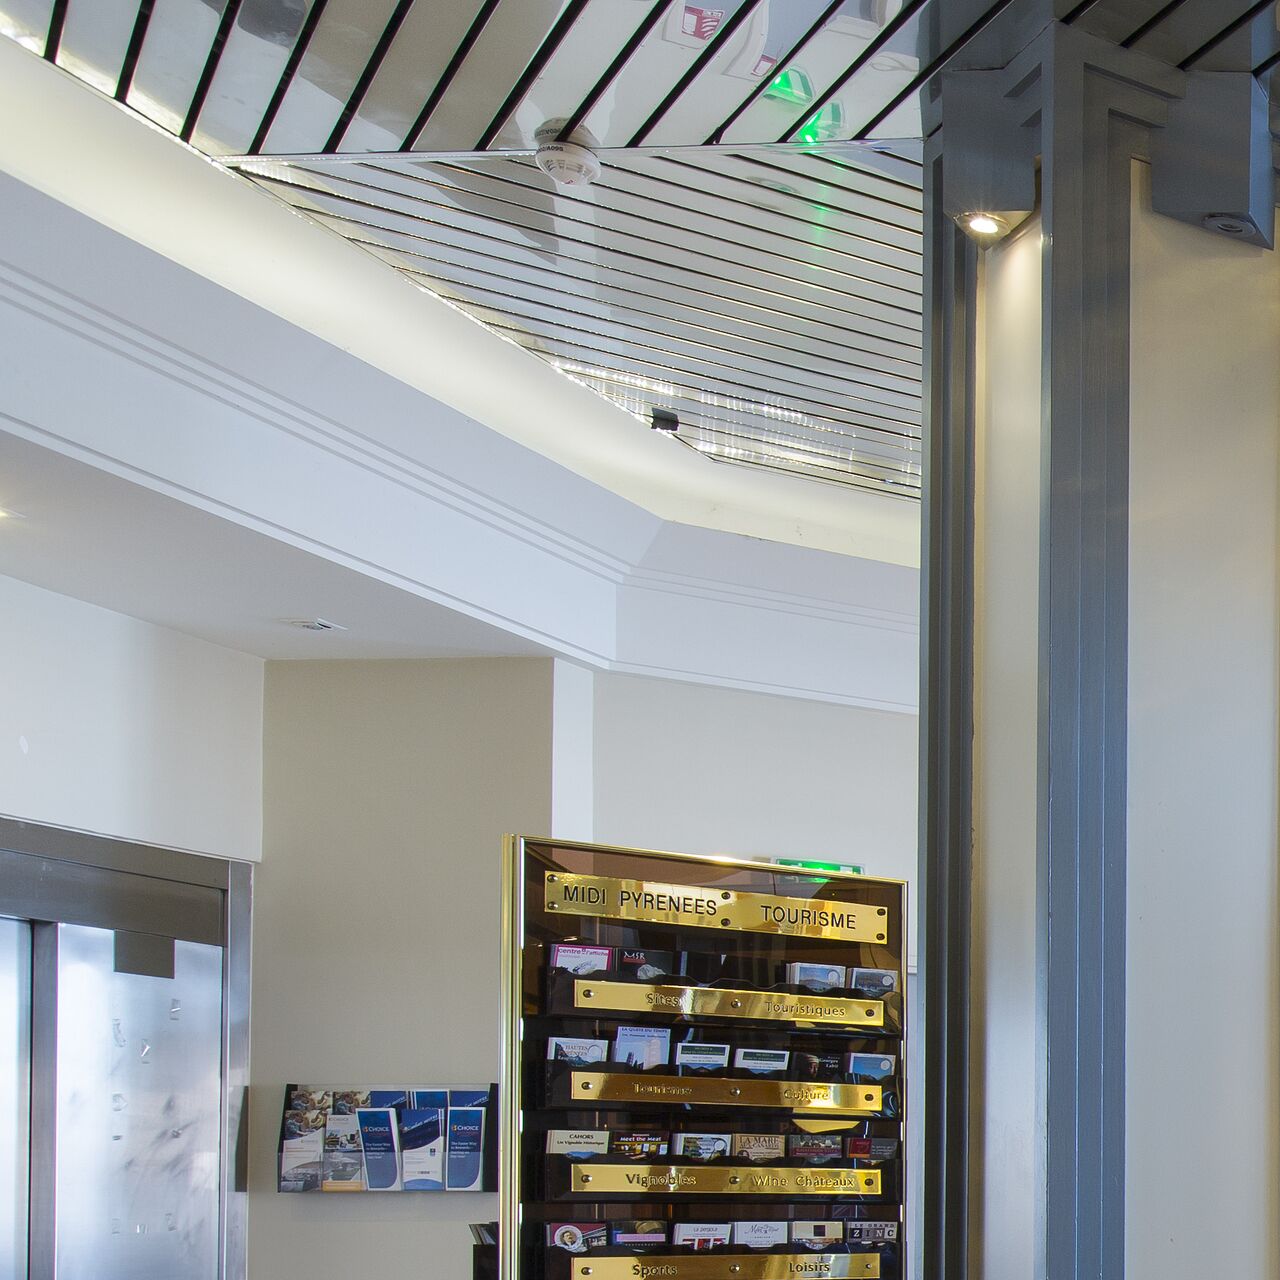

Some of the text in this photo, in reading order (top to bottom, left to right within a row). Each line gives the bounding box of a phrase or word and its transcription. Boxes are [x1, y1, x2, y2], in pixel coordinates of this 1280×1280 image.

[563, 884, 857, 930] MIDI PYRENEES TOURISME
[645, 992, 846, 1018] Sites Touristiques
[783, 1089, 830, 1101] Culture
[753, 1136, 779, 1144] MARE
[625, 1173, 855, 1188] Vignobles Wine Châteaux
[632, 1261, 830, 1279] Sports Loisirs
